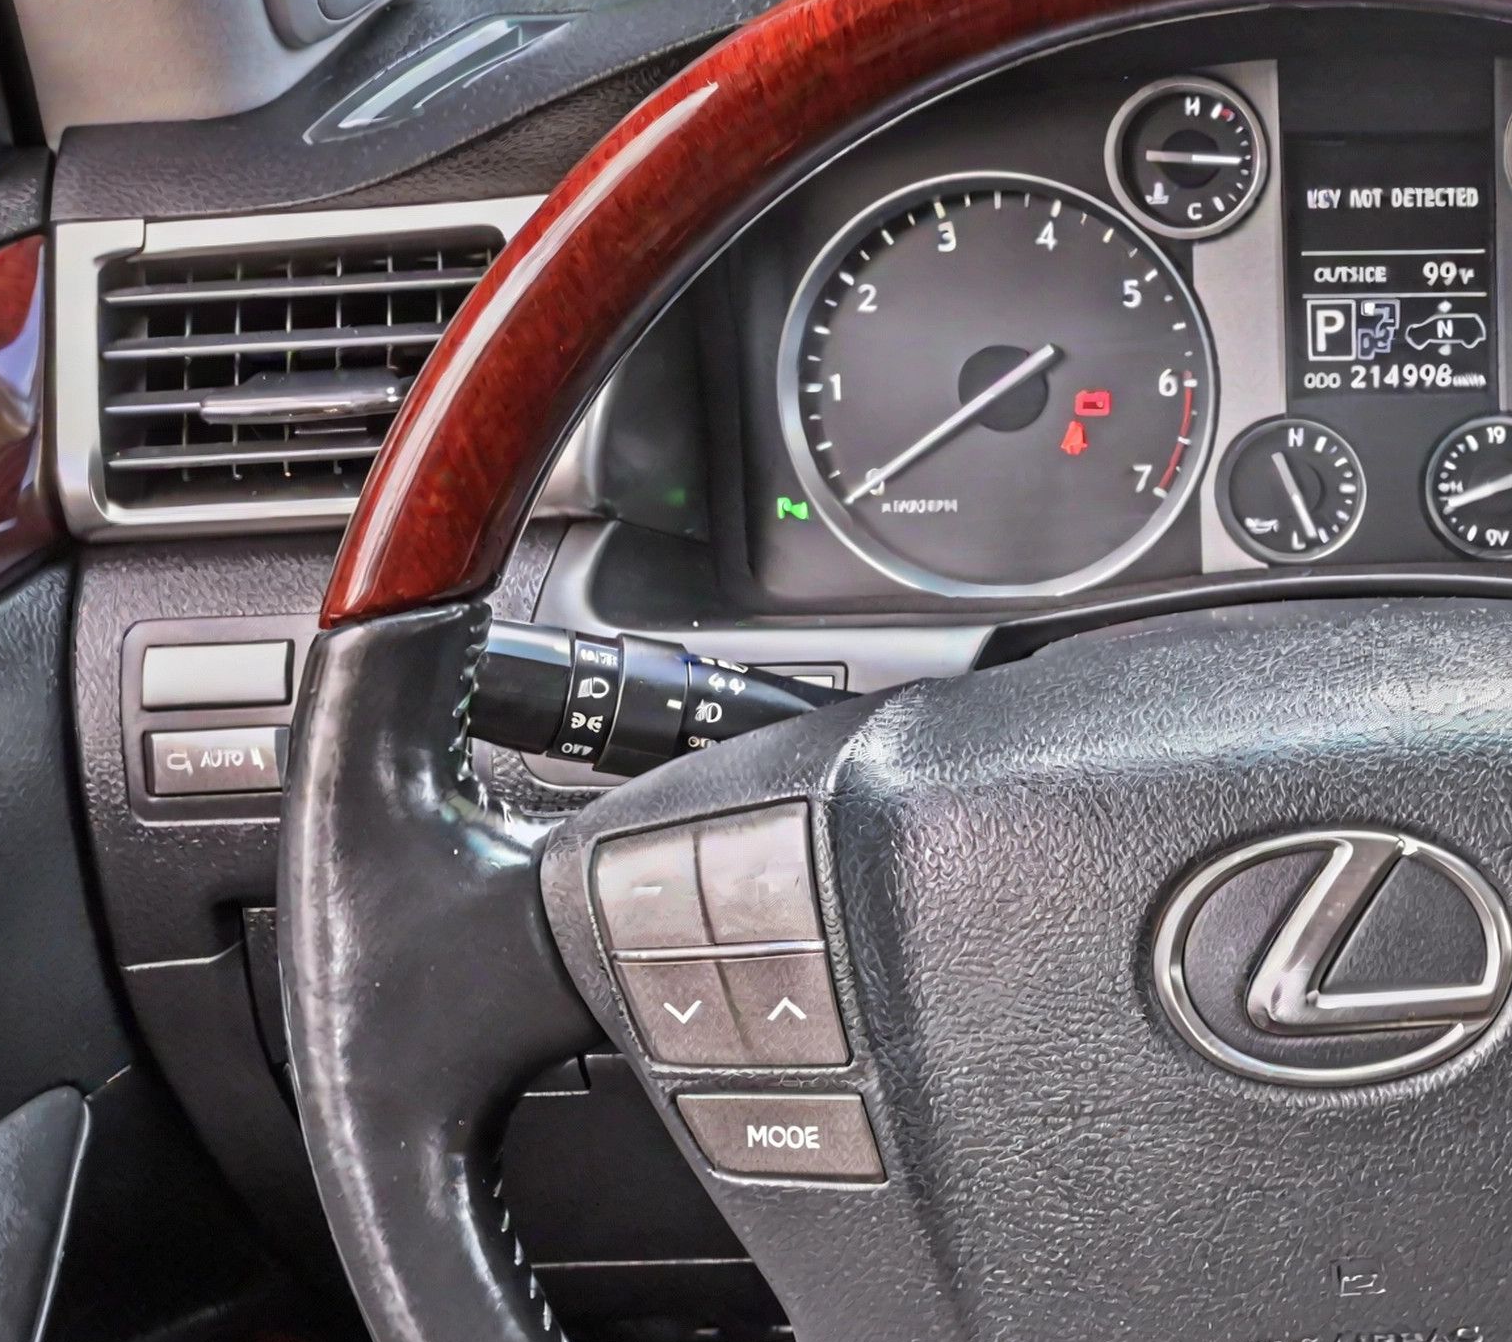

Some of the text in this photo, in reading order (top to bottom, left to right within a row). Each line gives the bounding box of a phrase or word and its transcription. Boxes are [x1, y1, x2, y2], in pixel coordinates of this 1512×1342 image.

[1349, 188, 1382, 209] NOT
[1391, 188, 1480, 209] DETECTED
[937, 222, 957, 252] 3
[1036, 222, 1058, 251] 4
[857, 284, 878, 313] 2
[1122, 280, 1143, 308] 5
[1316, 309, 1345, 352] P
[1437, 319, 1454, 339] N
[829, 373, 842, 401] 1
[1157, 369, 1178, 397] 6
[1304, 372, 1342, 389] ODO
[1133, 465, 1154, 493] 7
[746, 1124, 821, 1150] MODE
